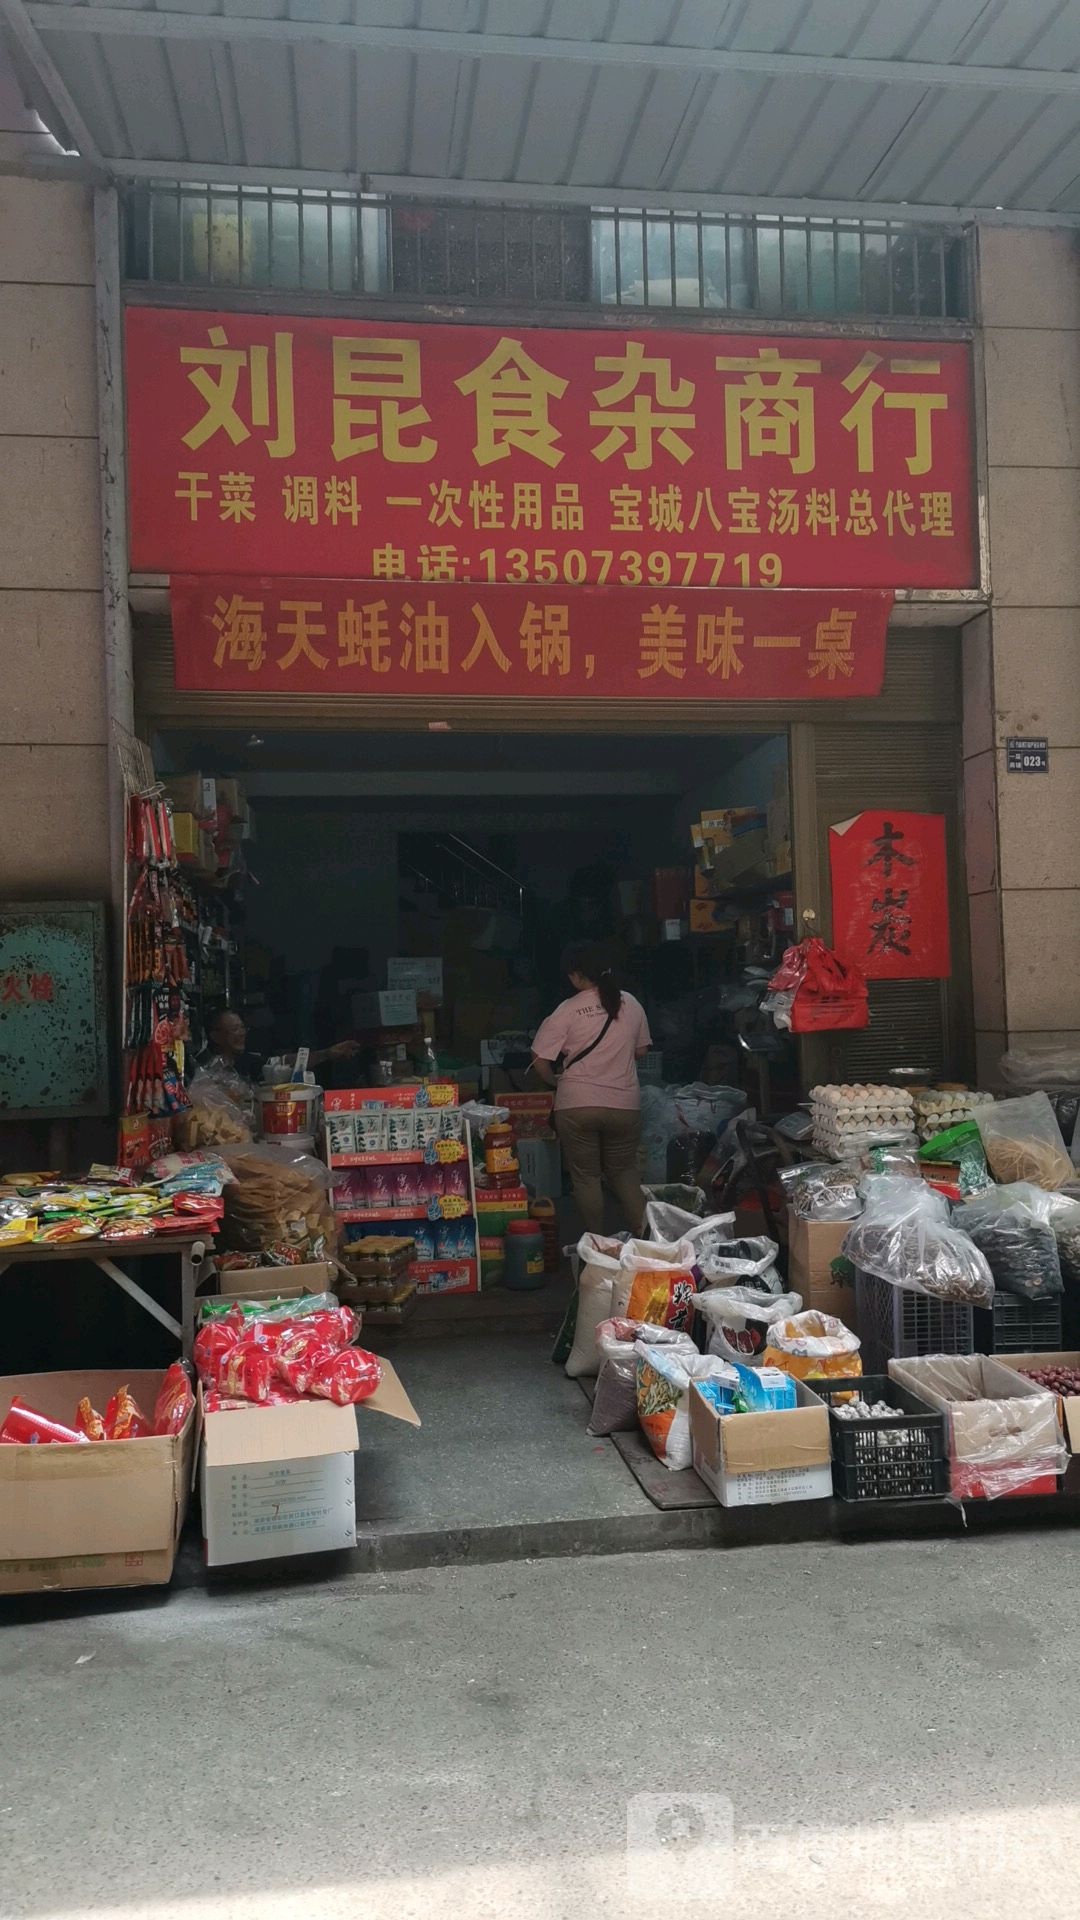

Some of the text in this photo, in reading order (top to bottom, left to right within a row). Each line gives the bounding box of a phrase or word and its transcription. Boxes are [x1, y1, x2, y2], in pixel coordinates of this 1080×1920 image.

[180, 326, 949, 476] 刘昆食杂商行
[175, 471, 955, 540] 干菜 调料 一次性用品 宝城八宝汤料总代理
